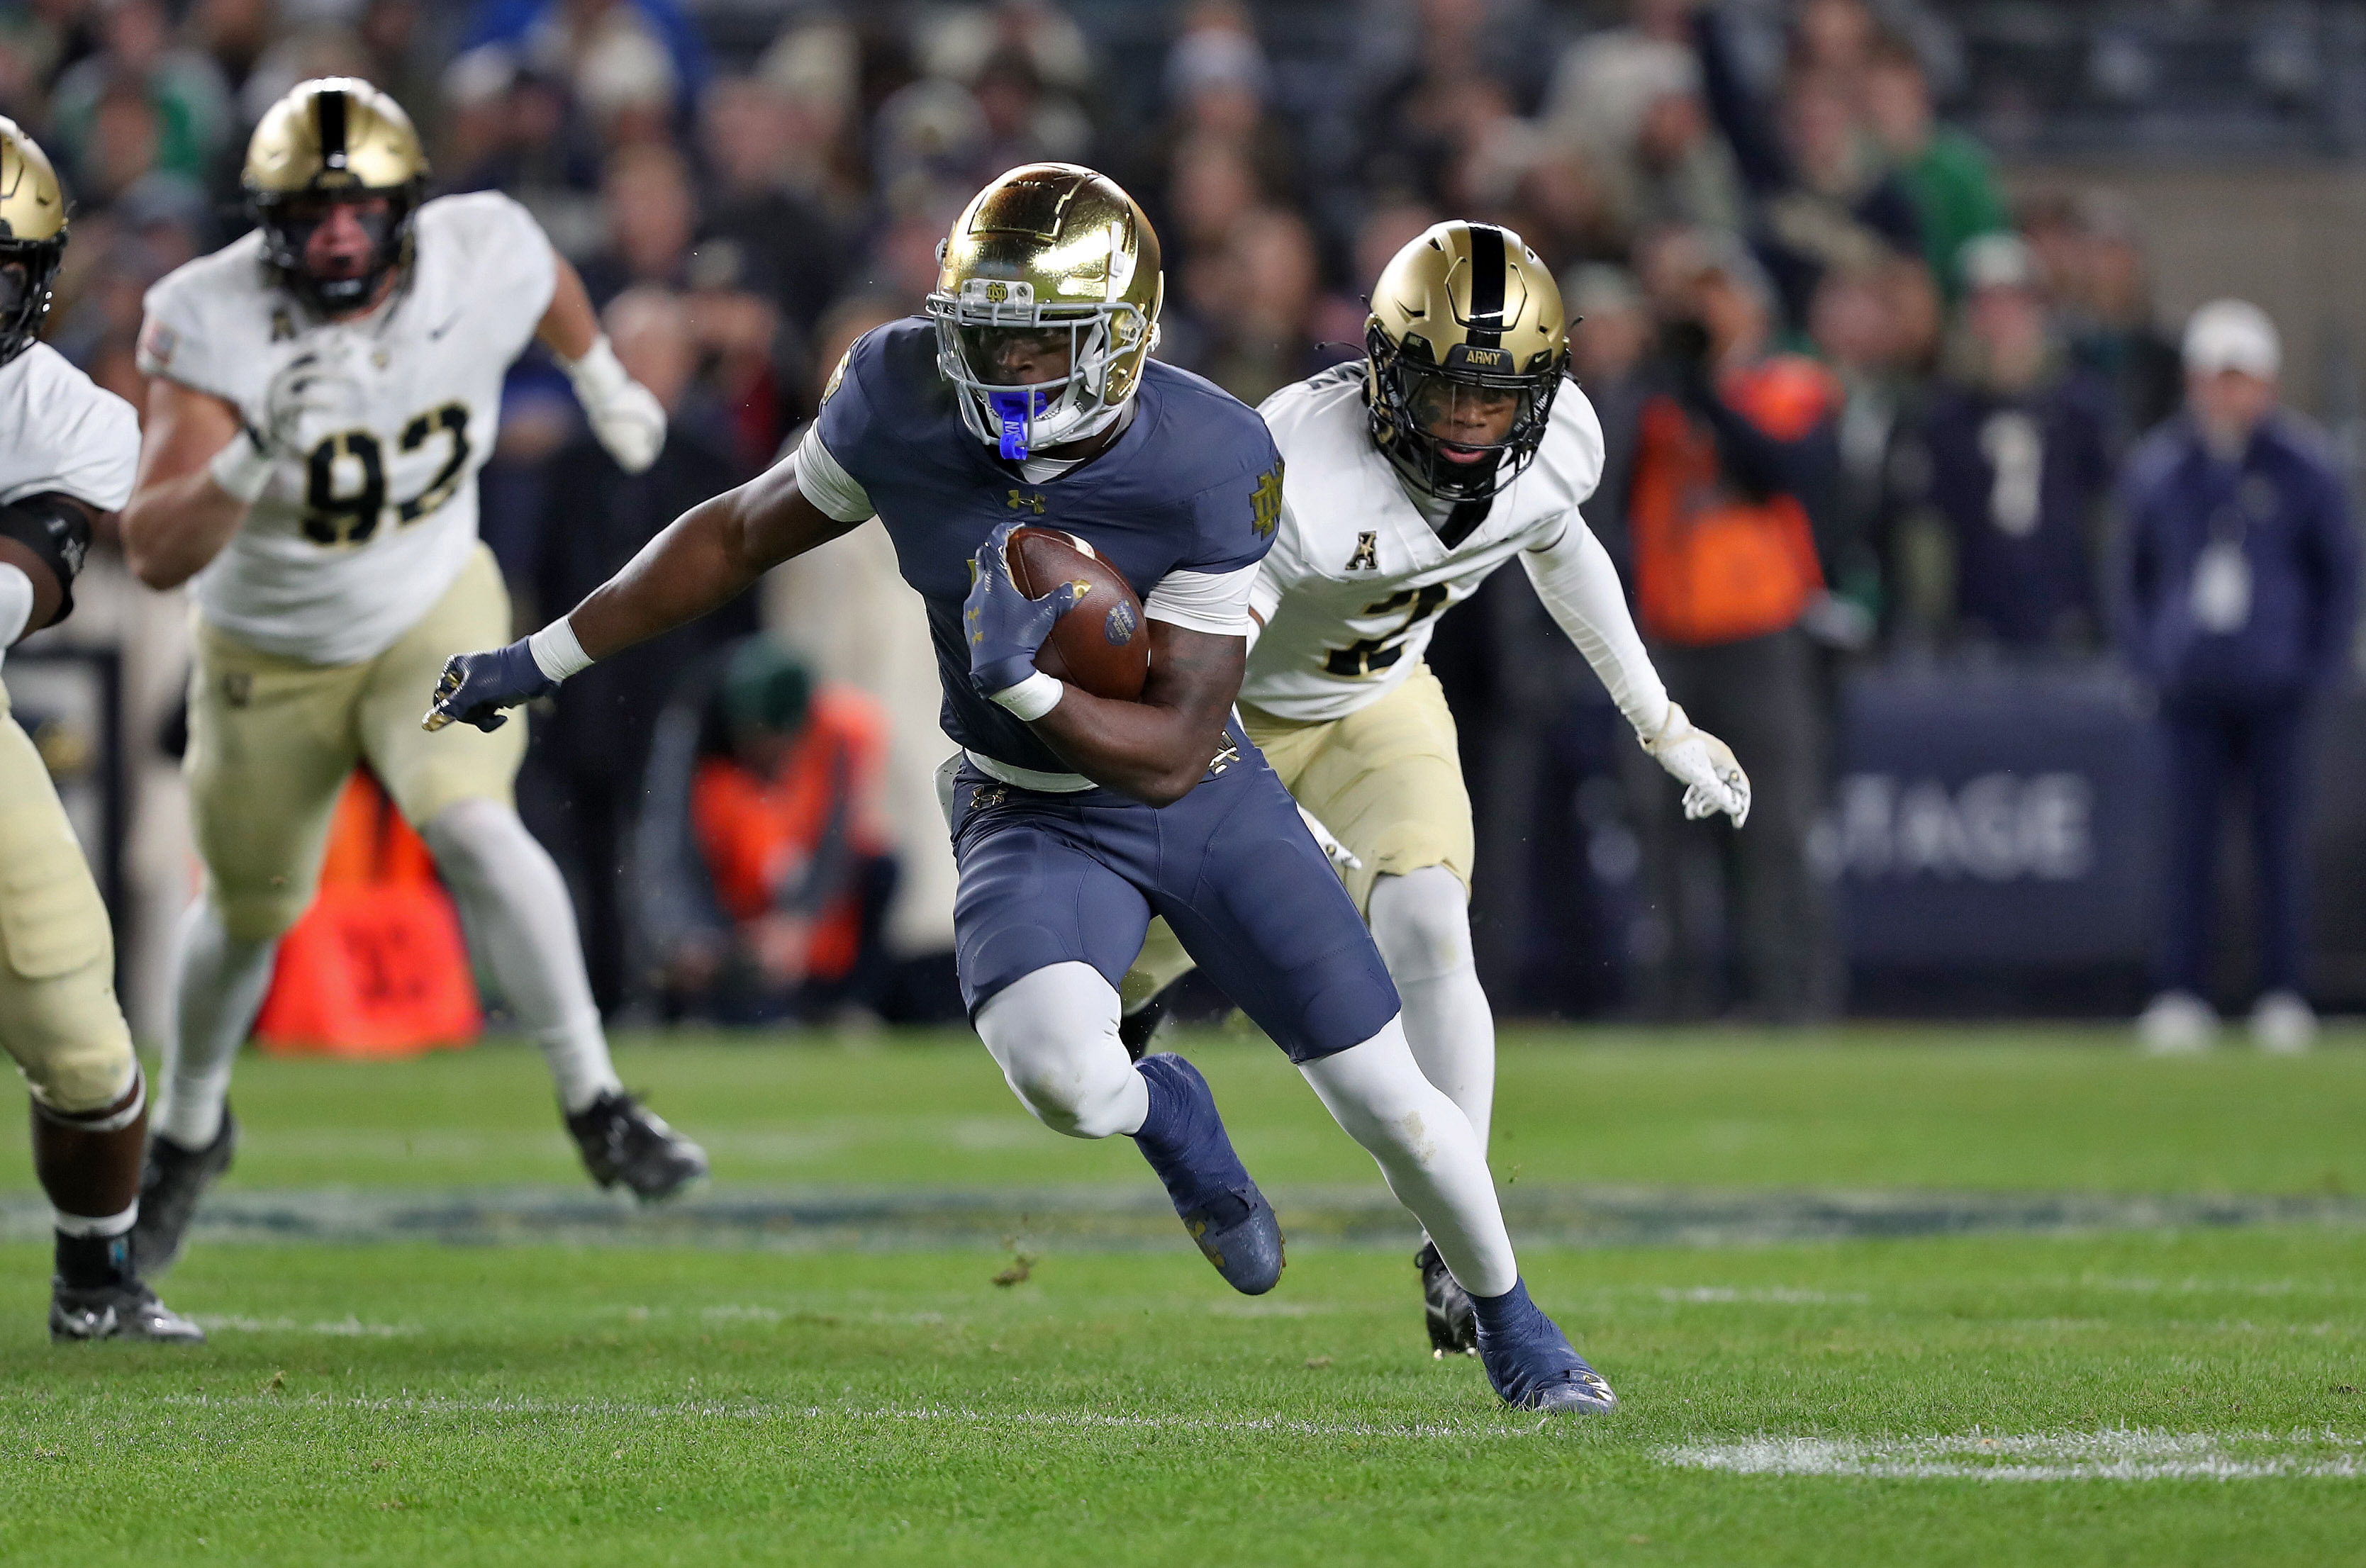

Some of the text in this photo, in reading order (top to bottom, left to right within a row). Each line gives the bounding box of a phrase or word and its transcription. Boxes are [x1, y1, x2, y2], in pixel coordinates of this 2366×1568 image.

[1465, 349, 1501, 366] ARMY
[299, 403, 472, 550] 92
[1345, 530, 1378, 570] A
[1322, 579, 1451, 678] 2
